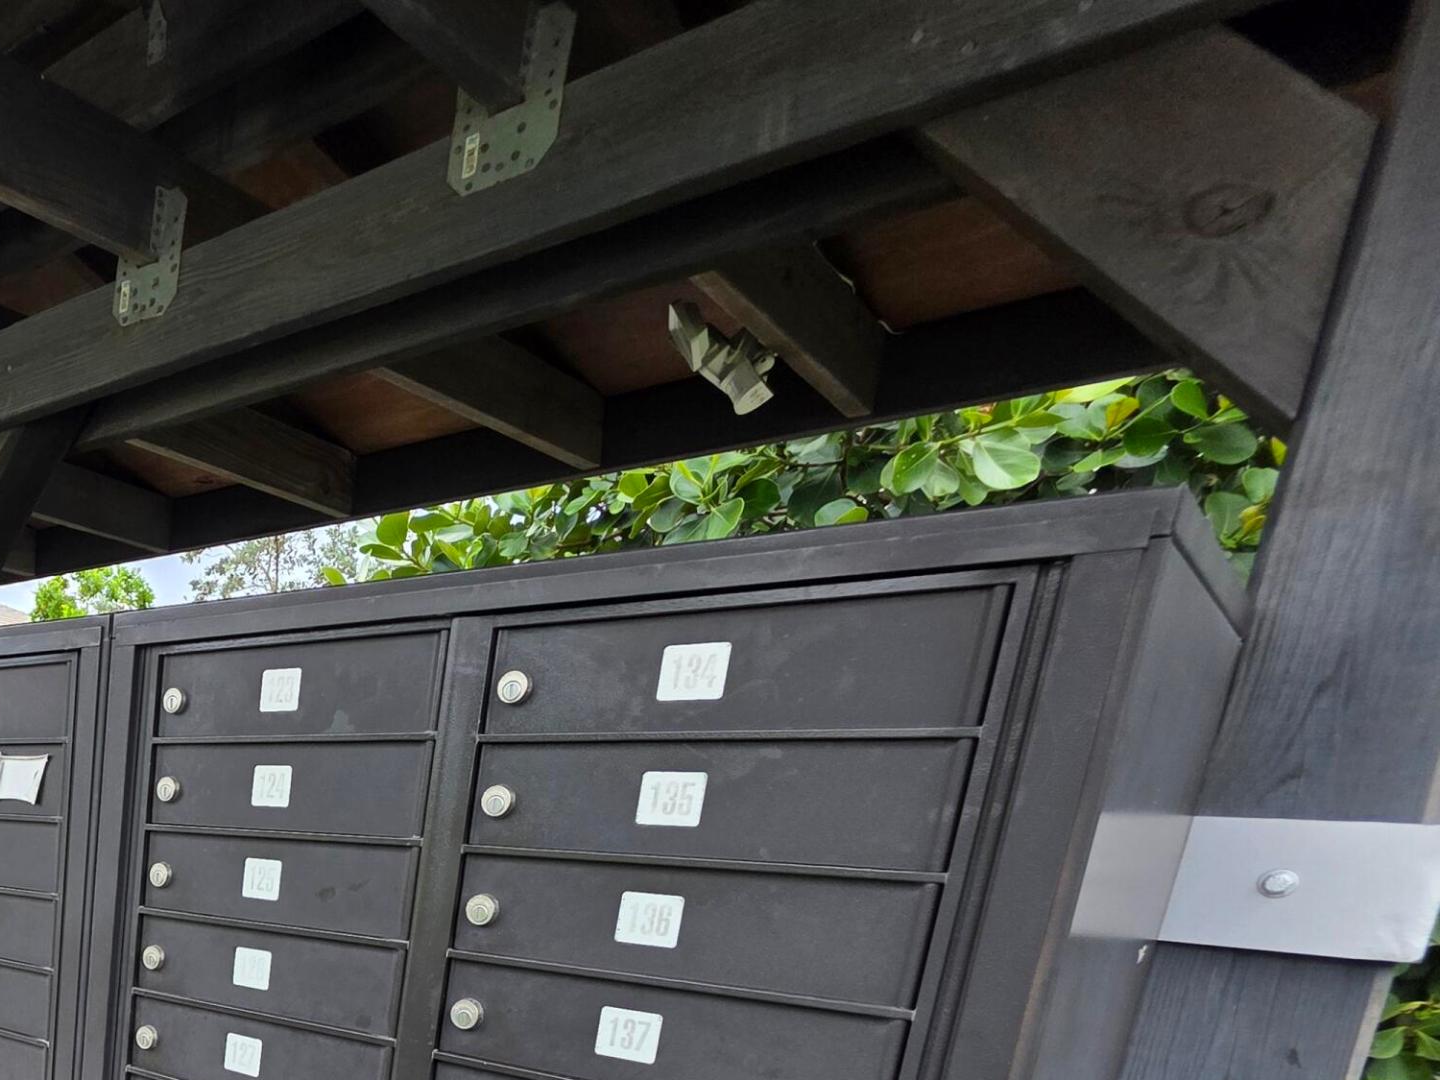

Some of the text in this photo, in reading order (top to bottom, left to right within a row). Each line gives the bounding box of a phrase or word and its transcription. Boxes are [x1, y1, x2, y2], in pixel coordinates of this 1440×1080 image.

[671, 653, 718, 690] 134
[260, 772, 285, 799] 124
[650, 781, 697, 816] 135
[250, 866, 275, 892] 125
[628, 902, 673, 937] 136
[609, 1017, 652, 1051] 137
